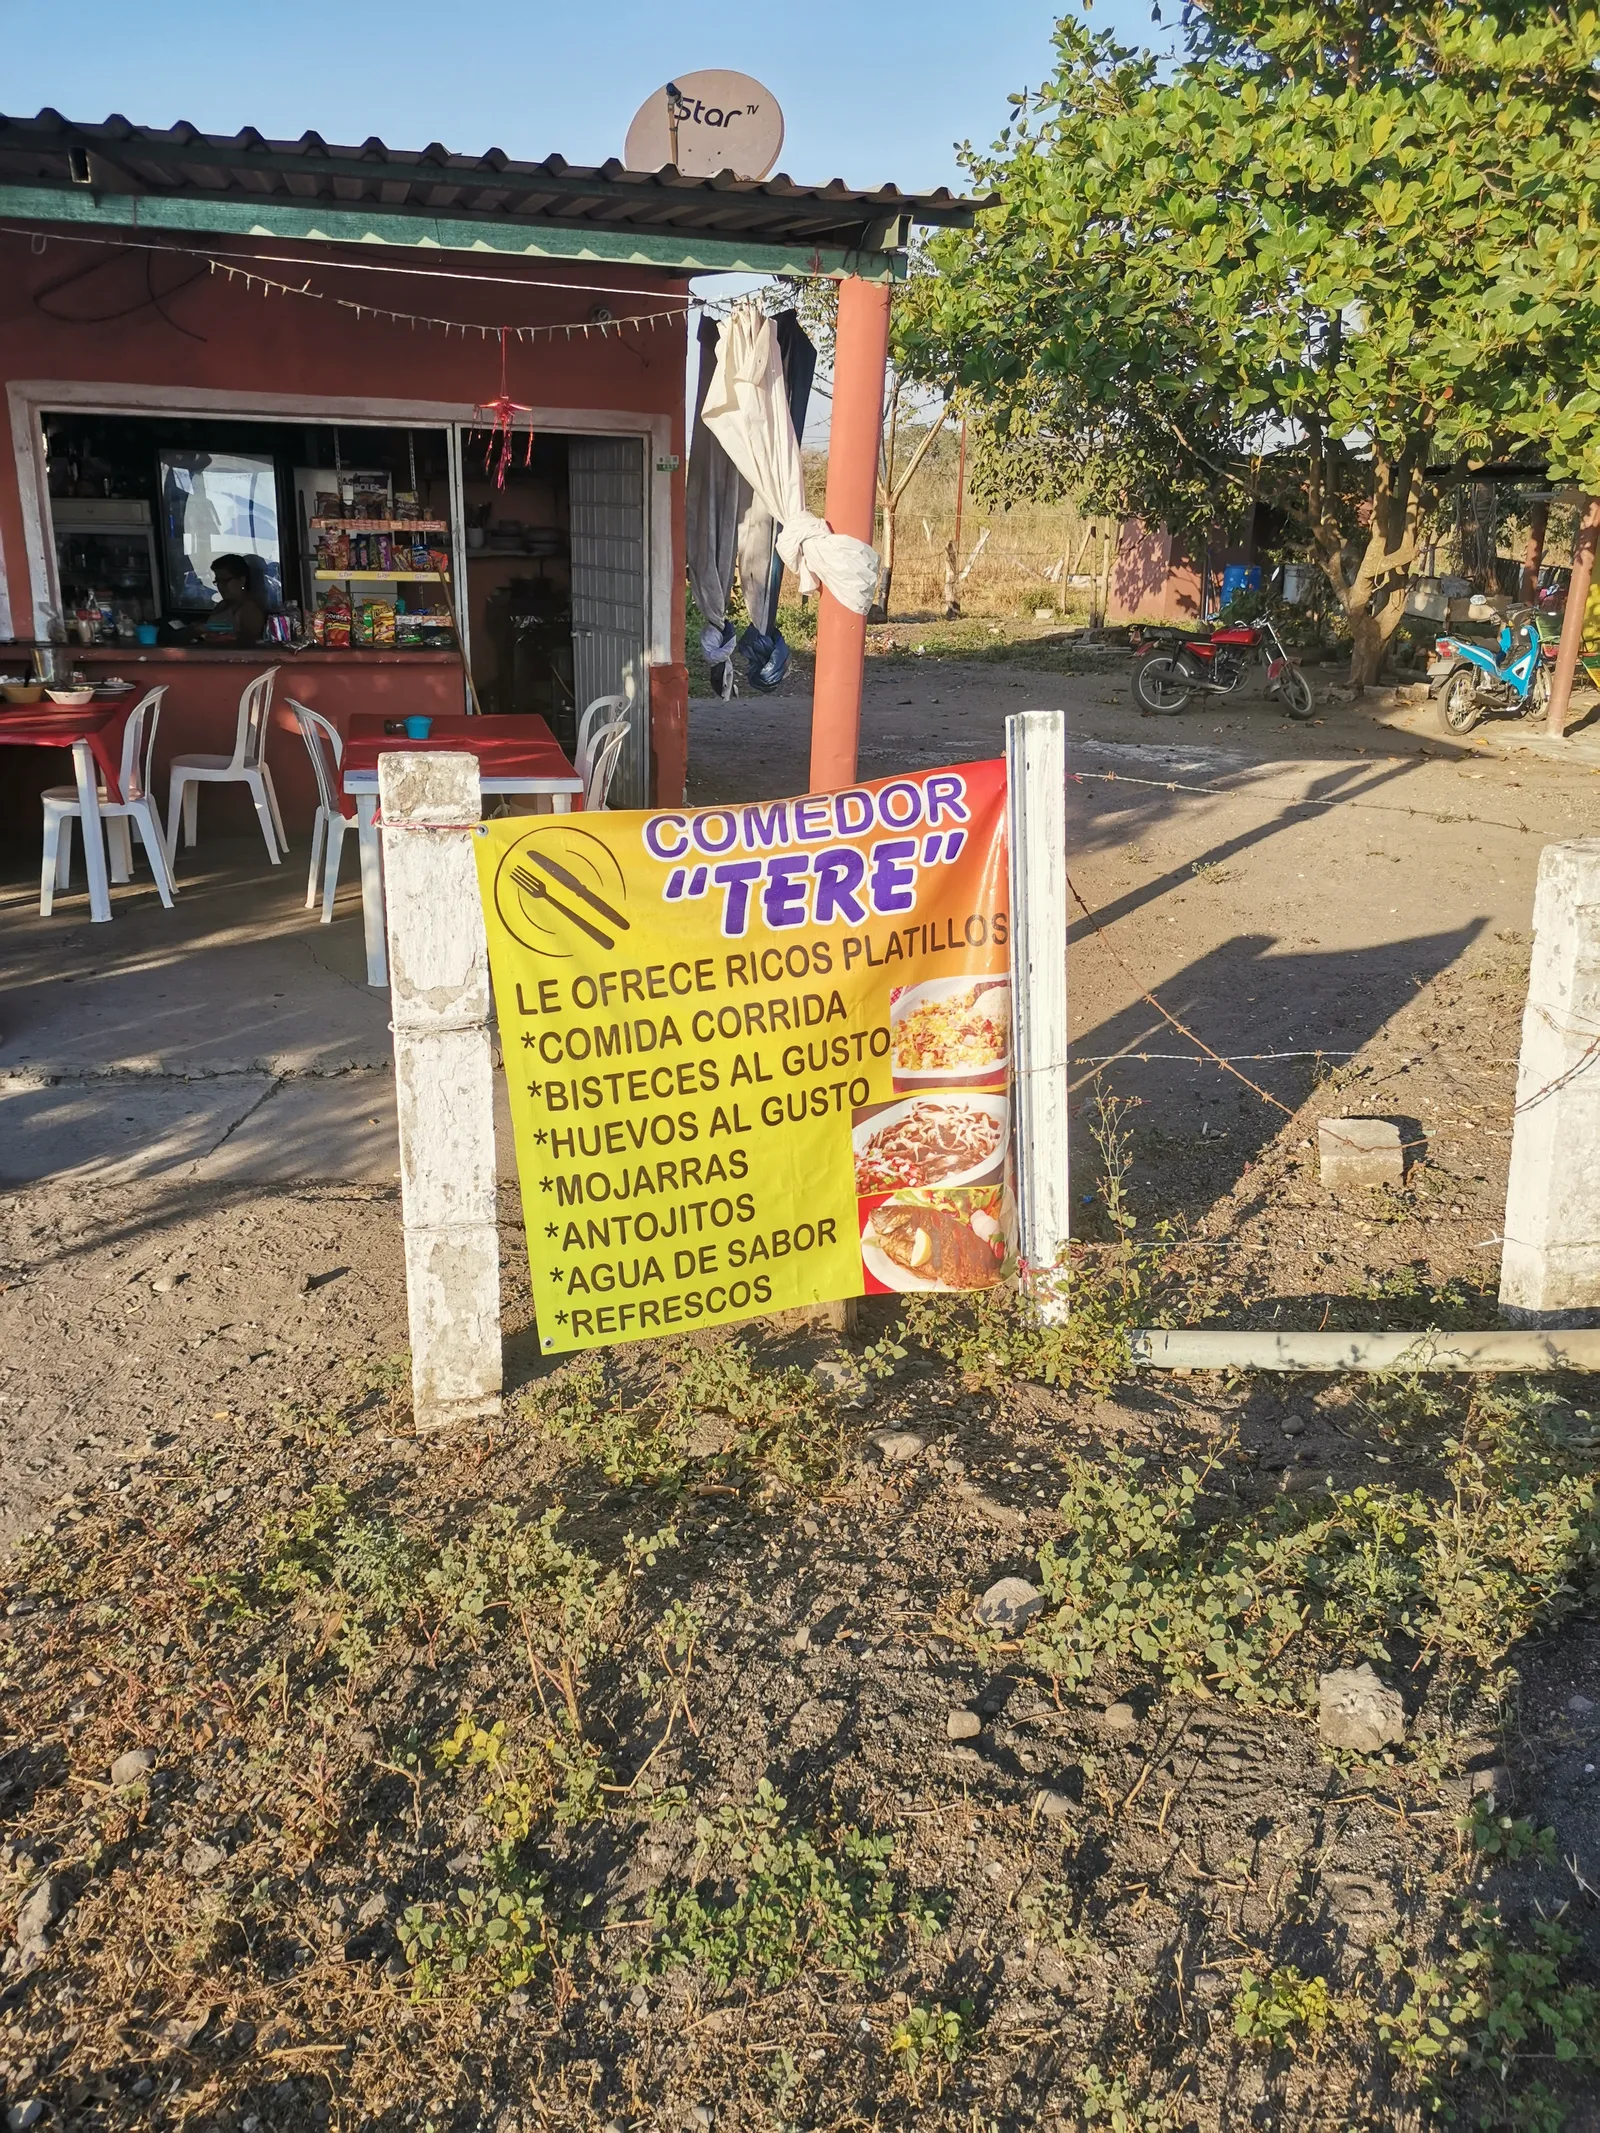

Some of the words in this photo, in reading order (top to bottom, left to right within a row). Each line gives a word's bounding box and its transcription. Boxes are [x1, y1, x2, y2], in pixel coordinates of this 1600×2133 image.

[674, 97, 742, 128] Star
[746, 105, 759, 115] TV
[645, 776, 968, 859] COMEDOR
[516, 978, 562, 1015] LE
[570, 957, 716, 1005] OFRECE
[725, 946, 834, 987] RICOS
[842, 912, 1009, 970] PLATILLOS
[691, 989, 848, 1042] CORRIDA
[729, 1051, 773, 1087] AL
[781, 1026, 892, 1076] GUSTO
[708, 1103, 752, 1138] AL
[760, 1077, 871, 1127] GUSTO
[674, 1245, 718, 1281] DE
[727, 1217, 838, 1268] SABOR
